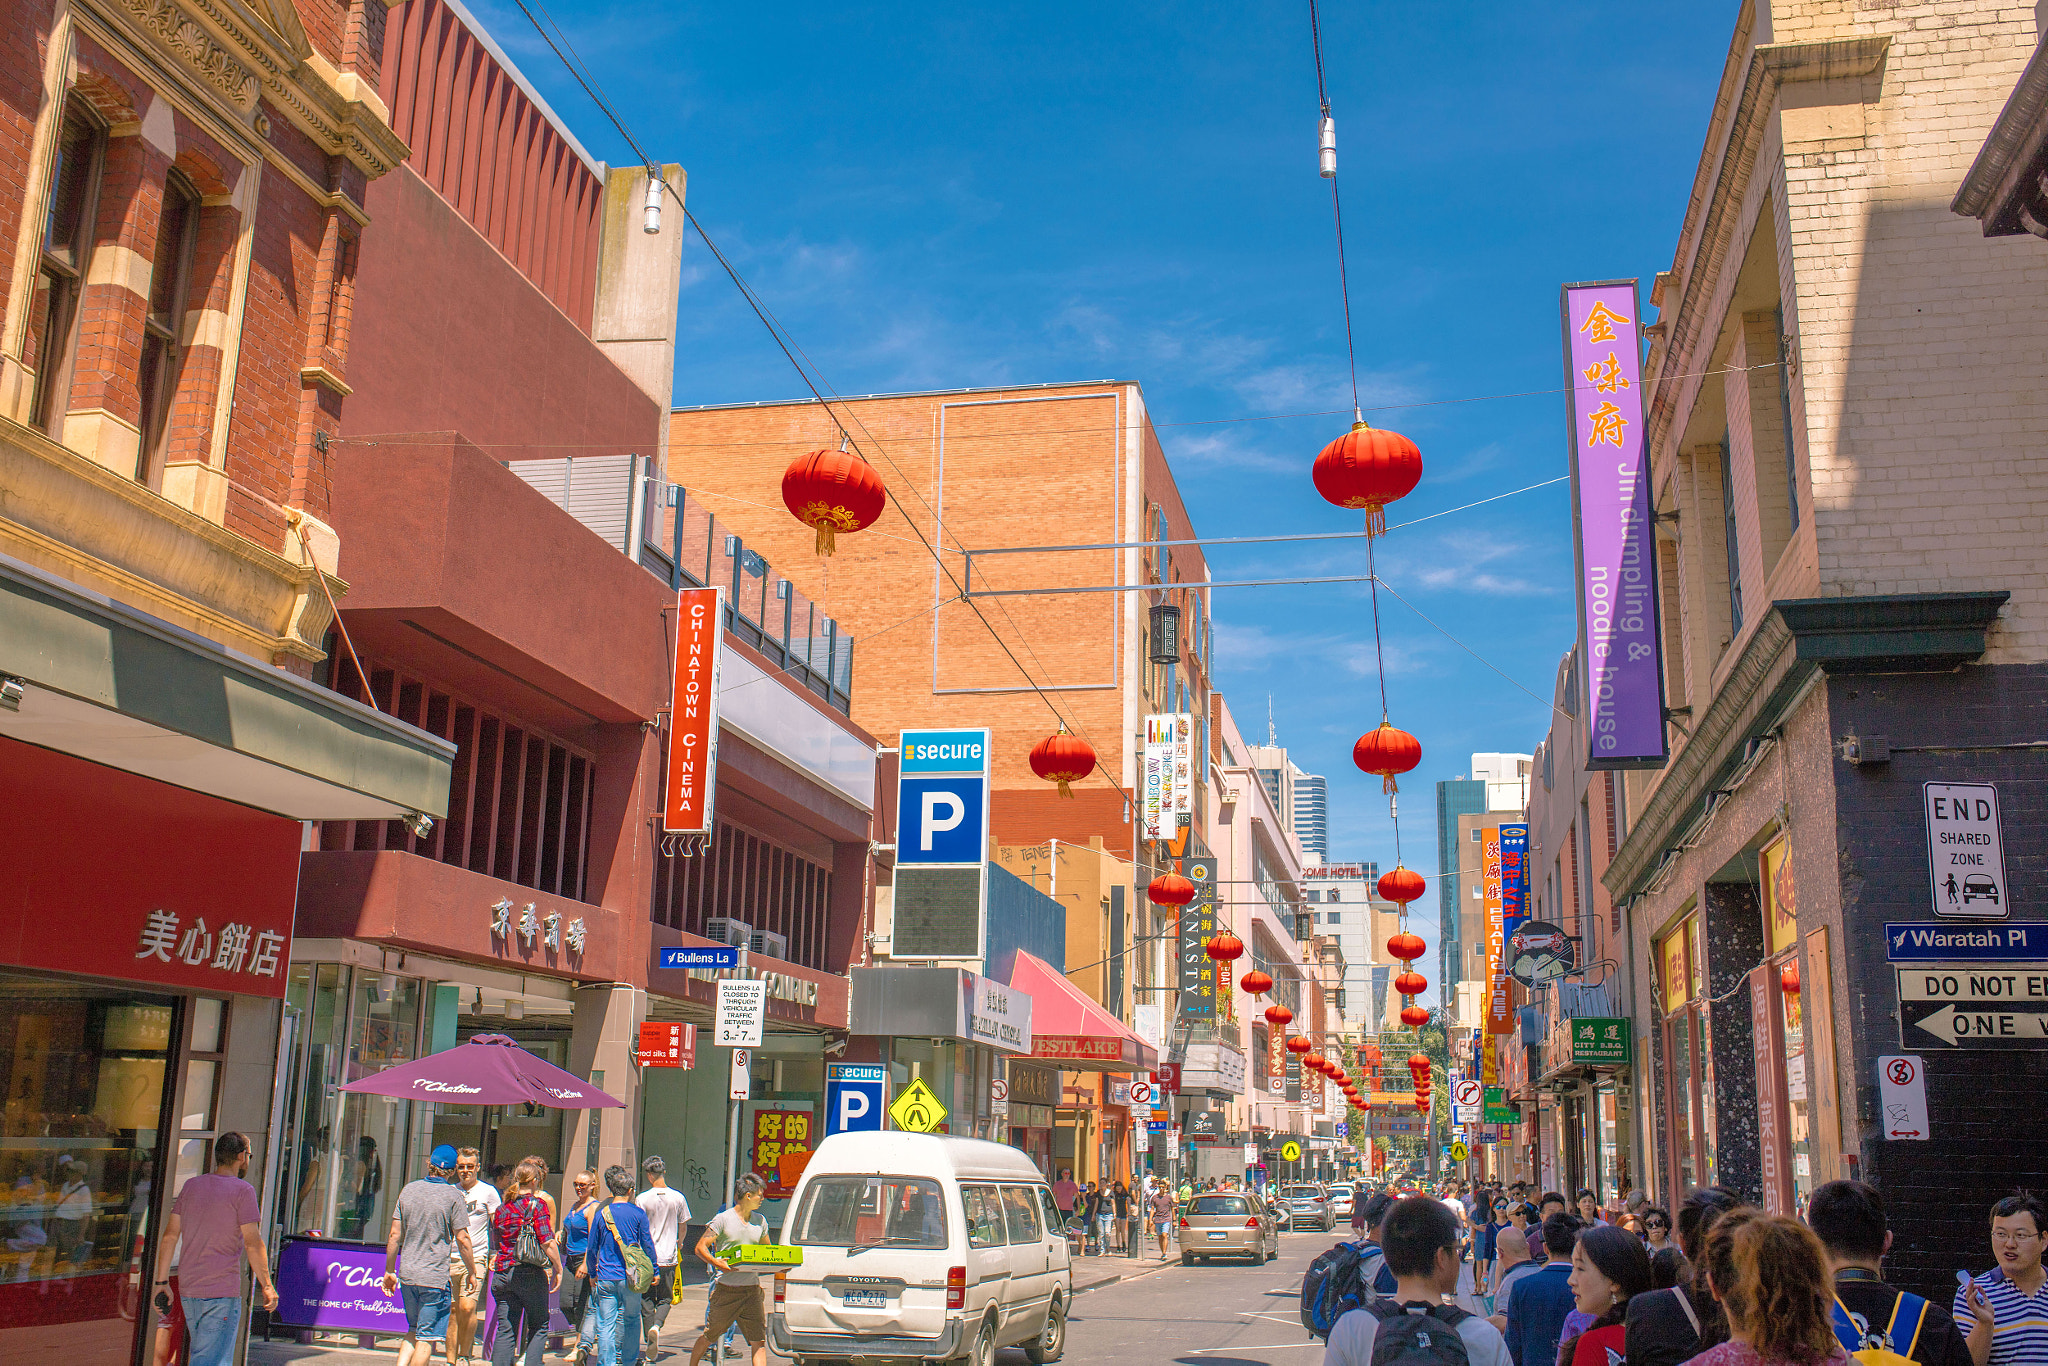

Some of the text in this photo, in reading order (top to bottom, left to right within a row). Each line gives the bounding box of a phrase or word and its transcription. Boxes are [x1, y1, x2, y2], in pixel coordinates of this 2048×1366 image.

[1580, 300, 1631, 449] 金味府
[1617, 462, 1651, 663] Jin dumpling &
[1590, 566, 1617, 751] noodle house
[680, 604, 705, 811] CHINATOWN CINEMA
[916, 743, 982, 760] secure
[1162, 749, 1173, 812] KARAOKE
[1148, 757, 1160, 837] RAINBOW
[1933, 797, 1991, 821] END
[920, 791, 965, 851] P
[1940, 831, 1991, 845] SHARED
[1330, 867, 1363, 876] HOTEL
[1950, 853, 1984, 865] ZONE
[1502, 851, 1523, 919] 海中之王
[135, 909, 285, 978] 美心餅店
[1911, 929, 2027, 948] Waratah Pl
[677, 952, 729, 963] Bullens La
[1489, 907, 1507, 1021] PETALING STREET
[1925, 976, 1958, 997] DO
[1970, 976, 2016, 997] NOT
[1952, 1014, 2016, 1036] ONE
[639, 1049, 652, 1057] red
[838, 1066, 881, 1078] secure
[424, 1082, 482, 1094] Chatime
[839, 1090, 870, 1131] P
[591, 1116, 599, 1155] CITY
[757, 1113, 809, 1141] 好的
[303, 1298, 317, 1307] THE
[318, 1299, 340, 1309] HOME
[341, 1301, 353, 1309] OF
